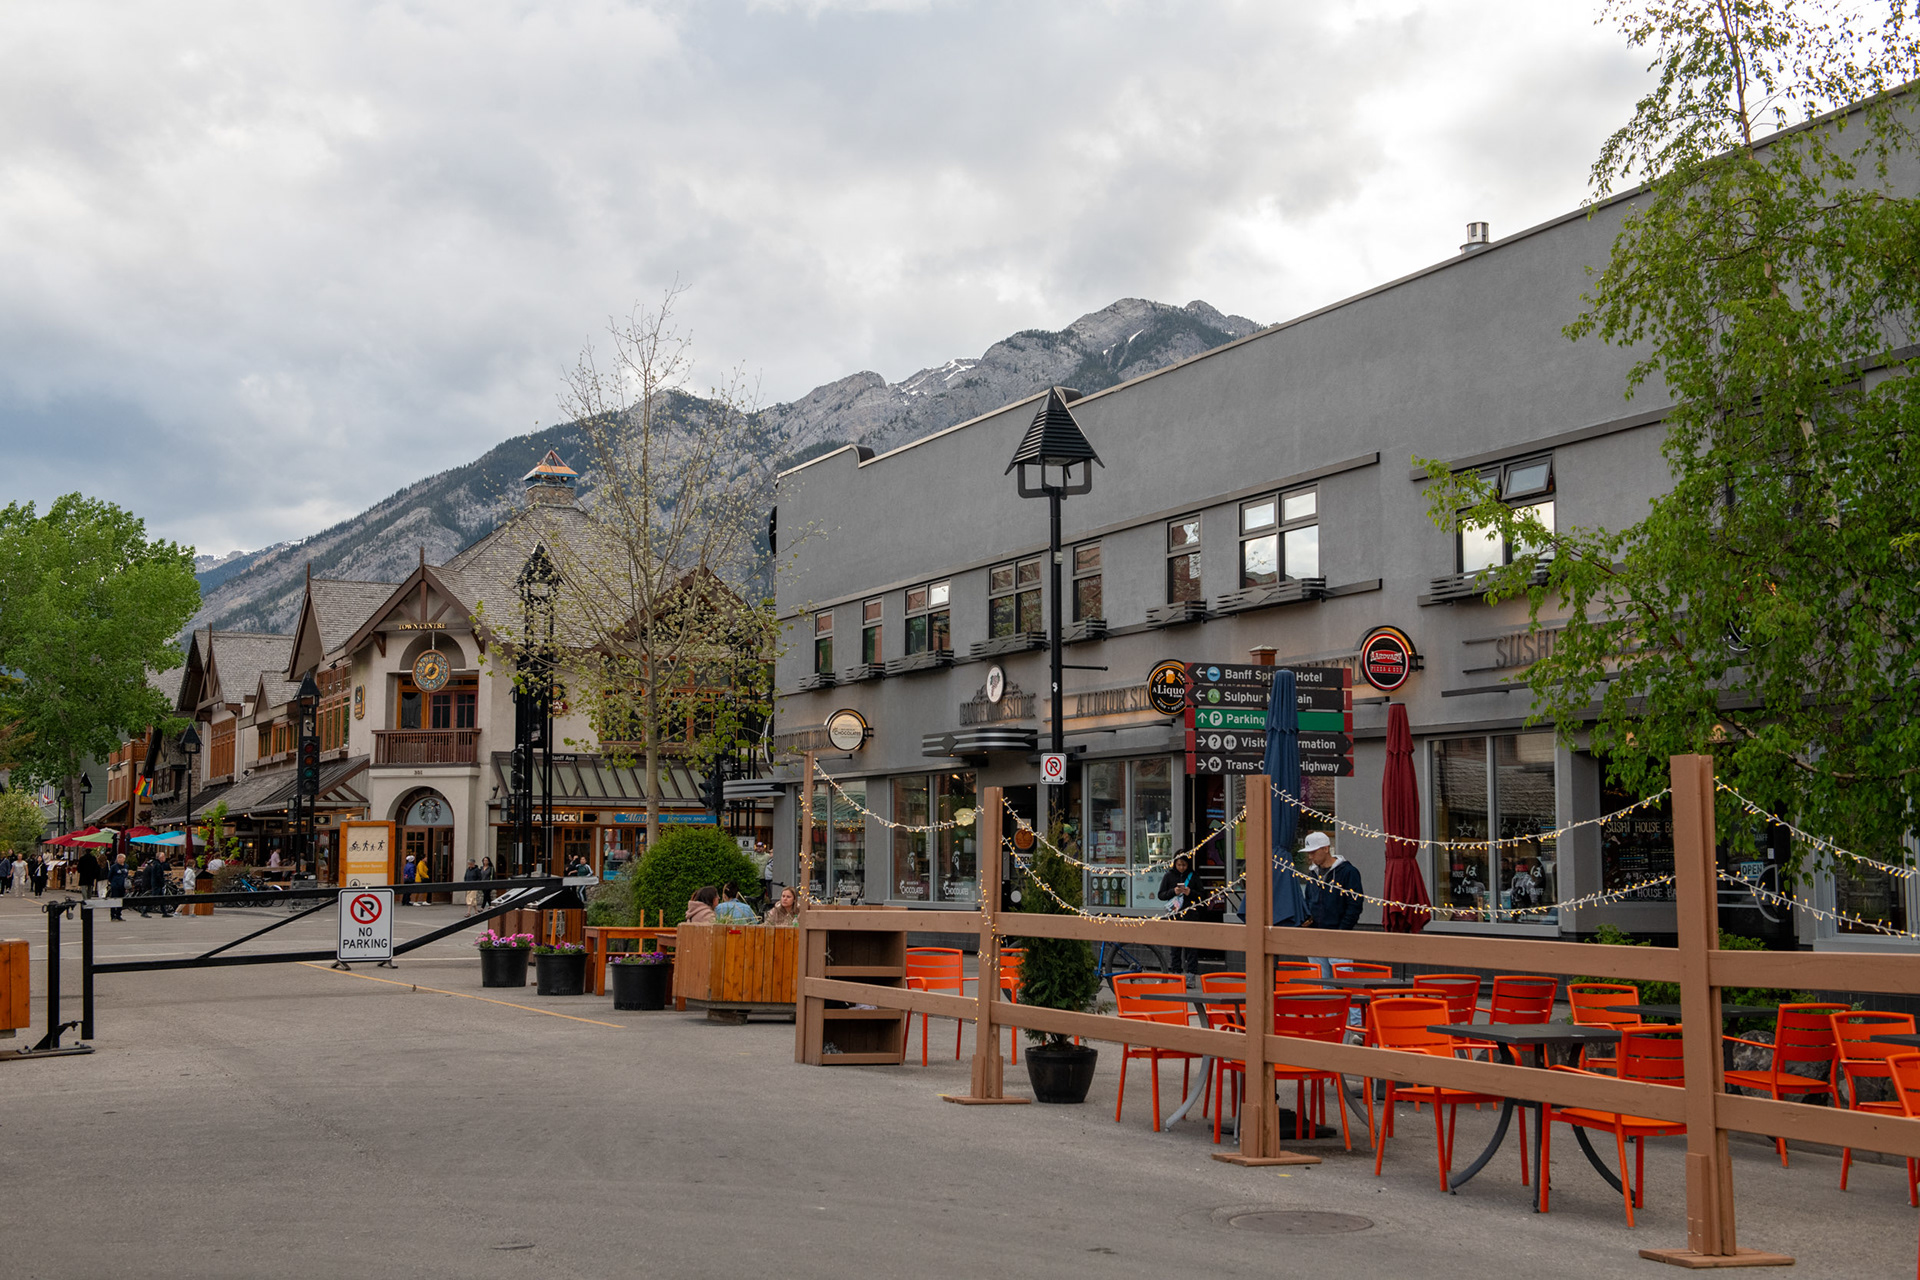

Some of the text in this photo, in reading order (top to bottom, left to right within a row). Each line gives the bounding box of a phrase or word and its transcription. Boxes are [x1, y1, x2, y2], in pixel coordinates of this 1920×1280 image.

[420, 622, 446, 630] CENTRE
[1225, 669, 1323, 683] Banff Spri Hotel
[1157, 685, 1185, 697] Liquo
[1076, 693, 1083, 718] A
[1086, 688, 1127, 717] LIQUOR
[1224, 691, 1264, 704] Sulphur
[1227, 714, 1265, 726] Parking
[1241, 737, 1336, 749] Visito rmation
[1226, 759, 1340, 773] Trans-C Highway
[1605, 821, 1631, 833] SUSHI
[1634, 821, 1661, 833] HOUSE
[1742, 864, 1763, 875] OPEN
[1638, 888, 1663, 898] HOUSE
[359, 927, 373, 937] NO
[342, 938, 388, 949] PARKING
